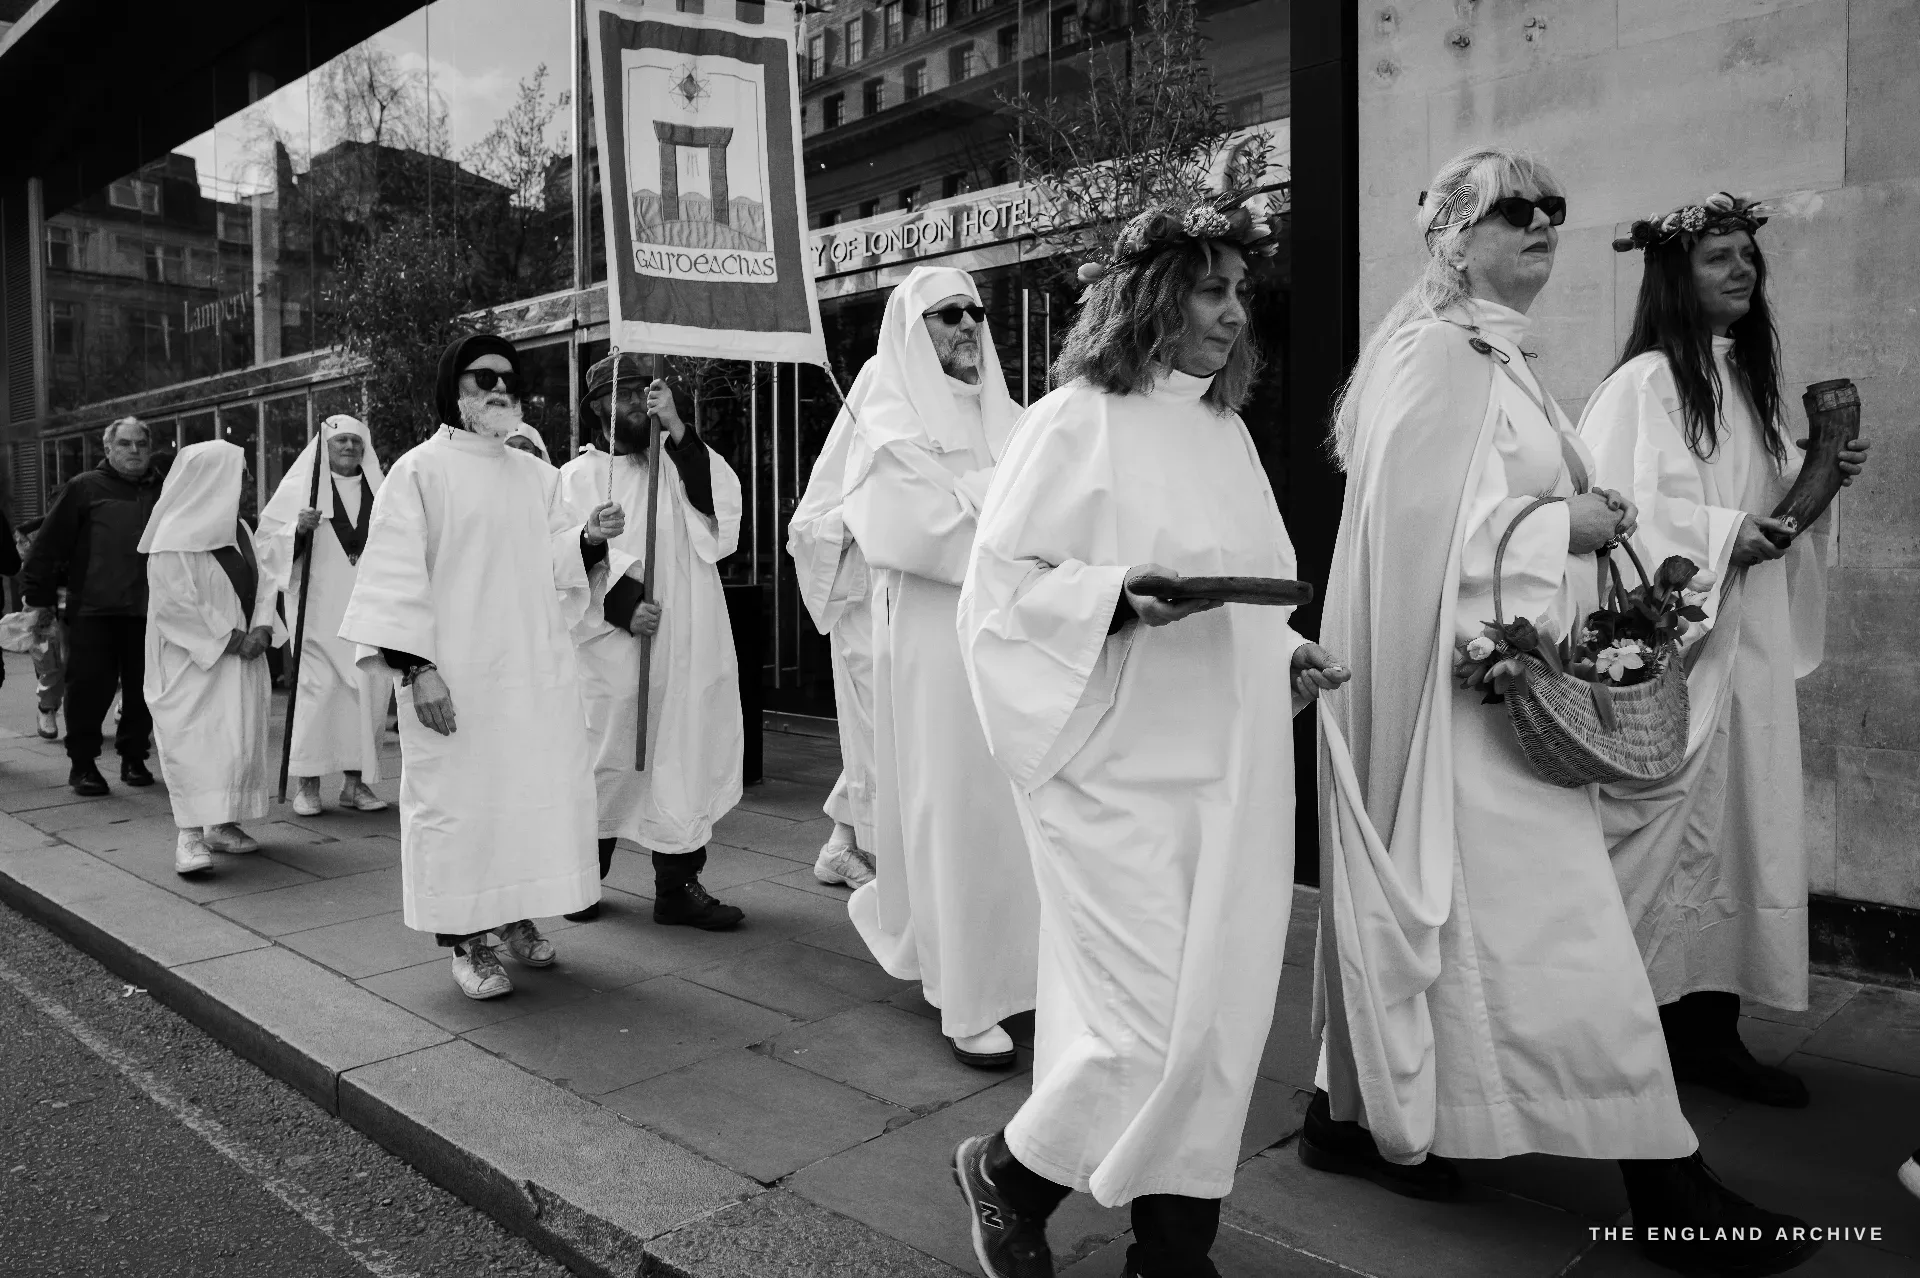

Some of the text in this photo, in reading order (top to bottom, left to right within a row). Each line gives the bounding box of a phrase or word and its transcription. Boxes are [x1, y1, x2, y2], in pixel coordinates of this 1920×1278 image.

[830, 236, 859, 264] OF
[862, 213, 955, 257] LONDON
[962, 198, 1035, 237] HOTEL
[978, 1200, 1004, 1230] N
